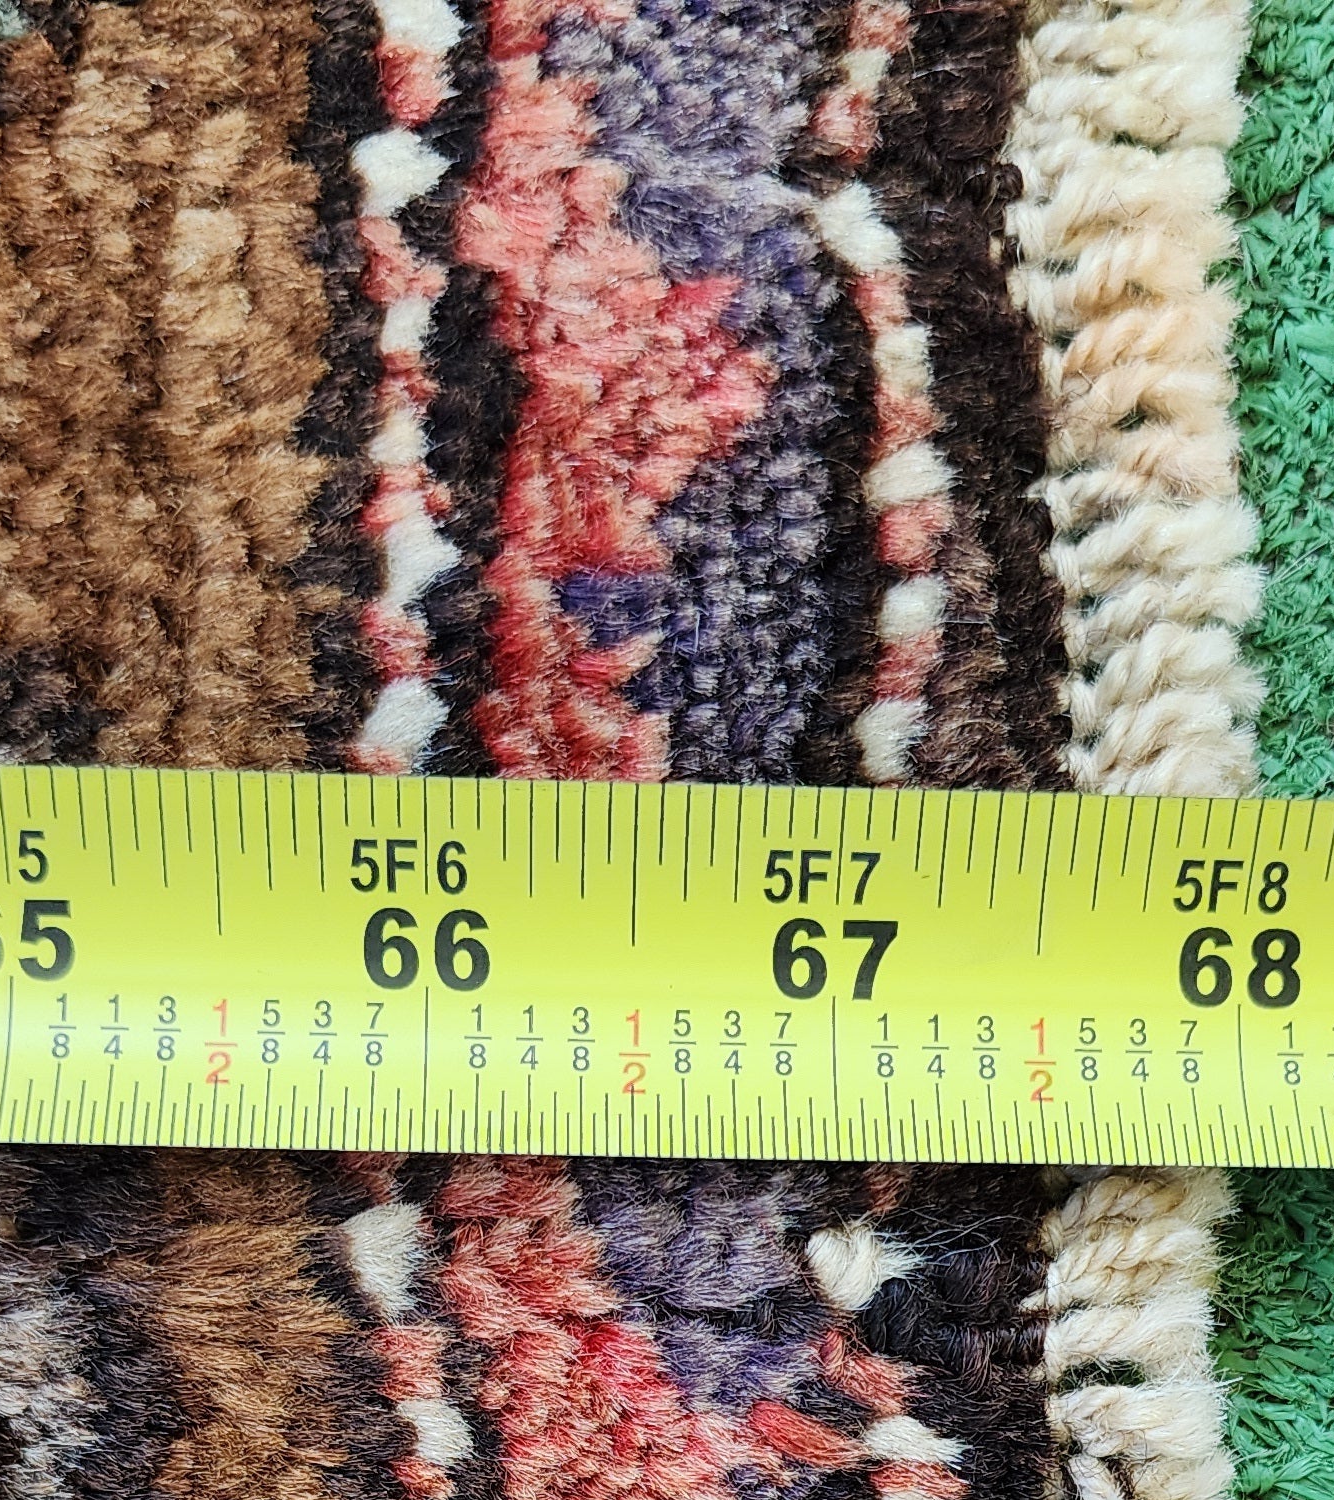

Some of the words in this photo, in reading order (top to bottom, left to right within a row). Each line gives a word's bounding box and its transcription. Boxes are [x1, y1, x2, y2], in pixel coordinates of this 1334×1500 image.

[364, 908, 491, 991] 66
[773, 918, 899, 1001] 67
[1179, 927, 1301, 1010] 68
